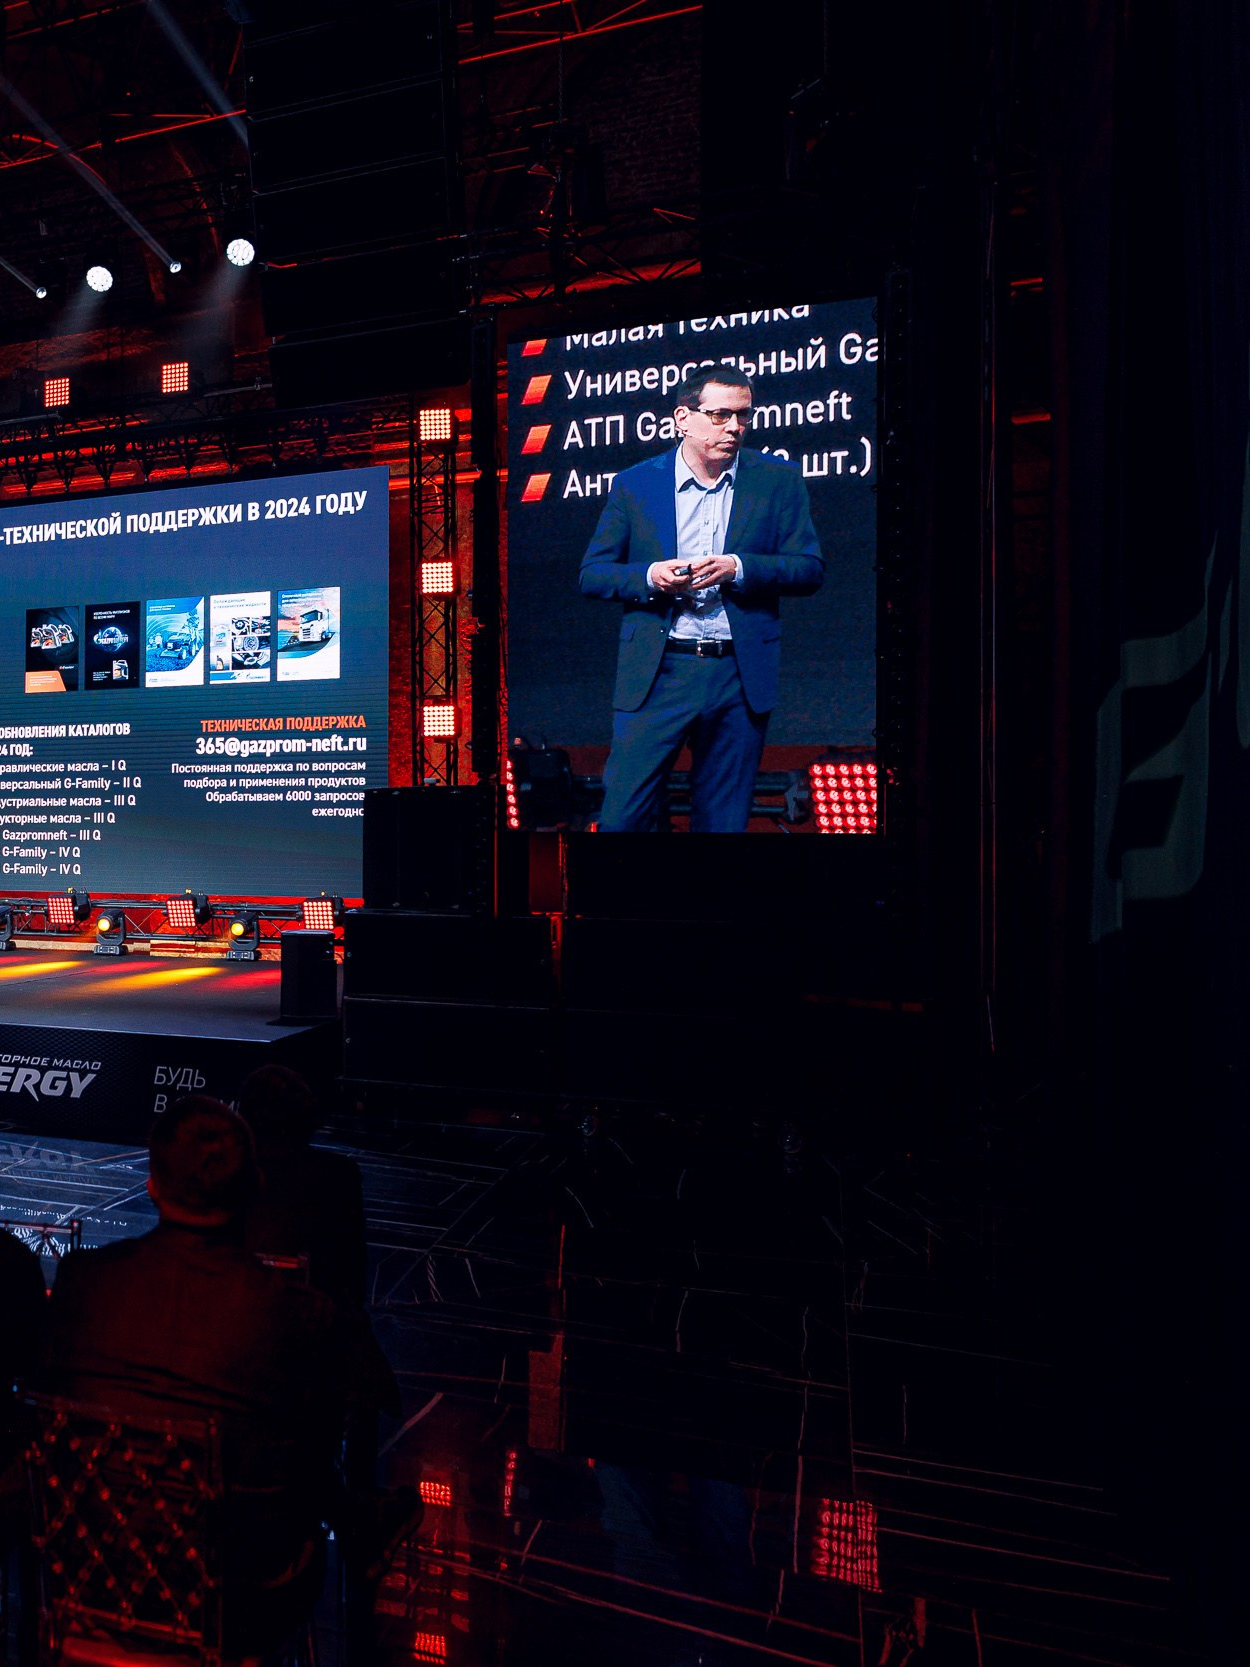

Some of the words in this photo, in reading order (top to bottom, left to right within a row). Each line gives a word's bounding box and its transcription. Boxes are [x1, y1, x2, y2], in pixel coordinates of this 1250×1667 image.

[563, 413, 624, 450] АТП
[636, 390, 852, 440] Gamneft
[801, 436, 872, 478] шт.)
[126, 503, 242, 533] ПОДДЕРЖКИ
[248, 502, 259, 521] В
[264, 497, 311, 520] 2024
[315, 491, 367, 515] ГОДУ
[68, 723, 130, 737] КАТАЛОГОВ
[201, 718, 283, 733] ТЕХНИЧЕСКАЯ
[286, 715, 366, 731] ПОДДЕРЖКА
[10, 744, 33, 757] ГОД:
[195, 734, 367, 757] 365@gazprom-neft.ru
[67, 763, 99, 772] масла
[117, 760, 126, 771] Q
[171, 763, 231, 774] Постоянная
[234, 763, 293, 774] поддержка
[296, 763, 309, 772] по
[312, 761, 366, 773] вопросам
[64, 778, 111, 790] G-Family
[123, 777, 130, 788] II
[133, 777, 142, 788] Q
[184, 777, 227, 789] подбора
[230, 777, 236, 787] и
[239, 777, 305, 788] применения
[308, 776, 366, 788] продуктов
[69, 796, 101, 806] масла
[114, 795, 125, 806] III
[127, 795, 136, 806] Q
[206, 791, 283, 803] Обрабатываем
[286, 791, 312, 801] 6000
[314, 792, 365, 803] запросов
[50, 814, 81, 823] масла
[93, 812, 104, 823] III
[107, 812, 116, 823] Q
[2, 829, 68, 842] Gazpromneft
[79, 829, 90, 840] III
[92, 829, 101, 841] Q
[2, 846, 47, 859] G-Family
[58, 847, 70, 858] IV
[72, 847, 81, 858] Q
[2, 863, 48, 876] G-Family
[59, 864, 71, 875] IV
[72, 864, 81, 875] Q
[52, 1058, 102, 1070] МАСЛО
[153, 1065, 206, 1091] БУДЬ
[153, 1093, 168, 1113] В
